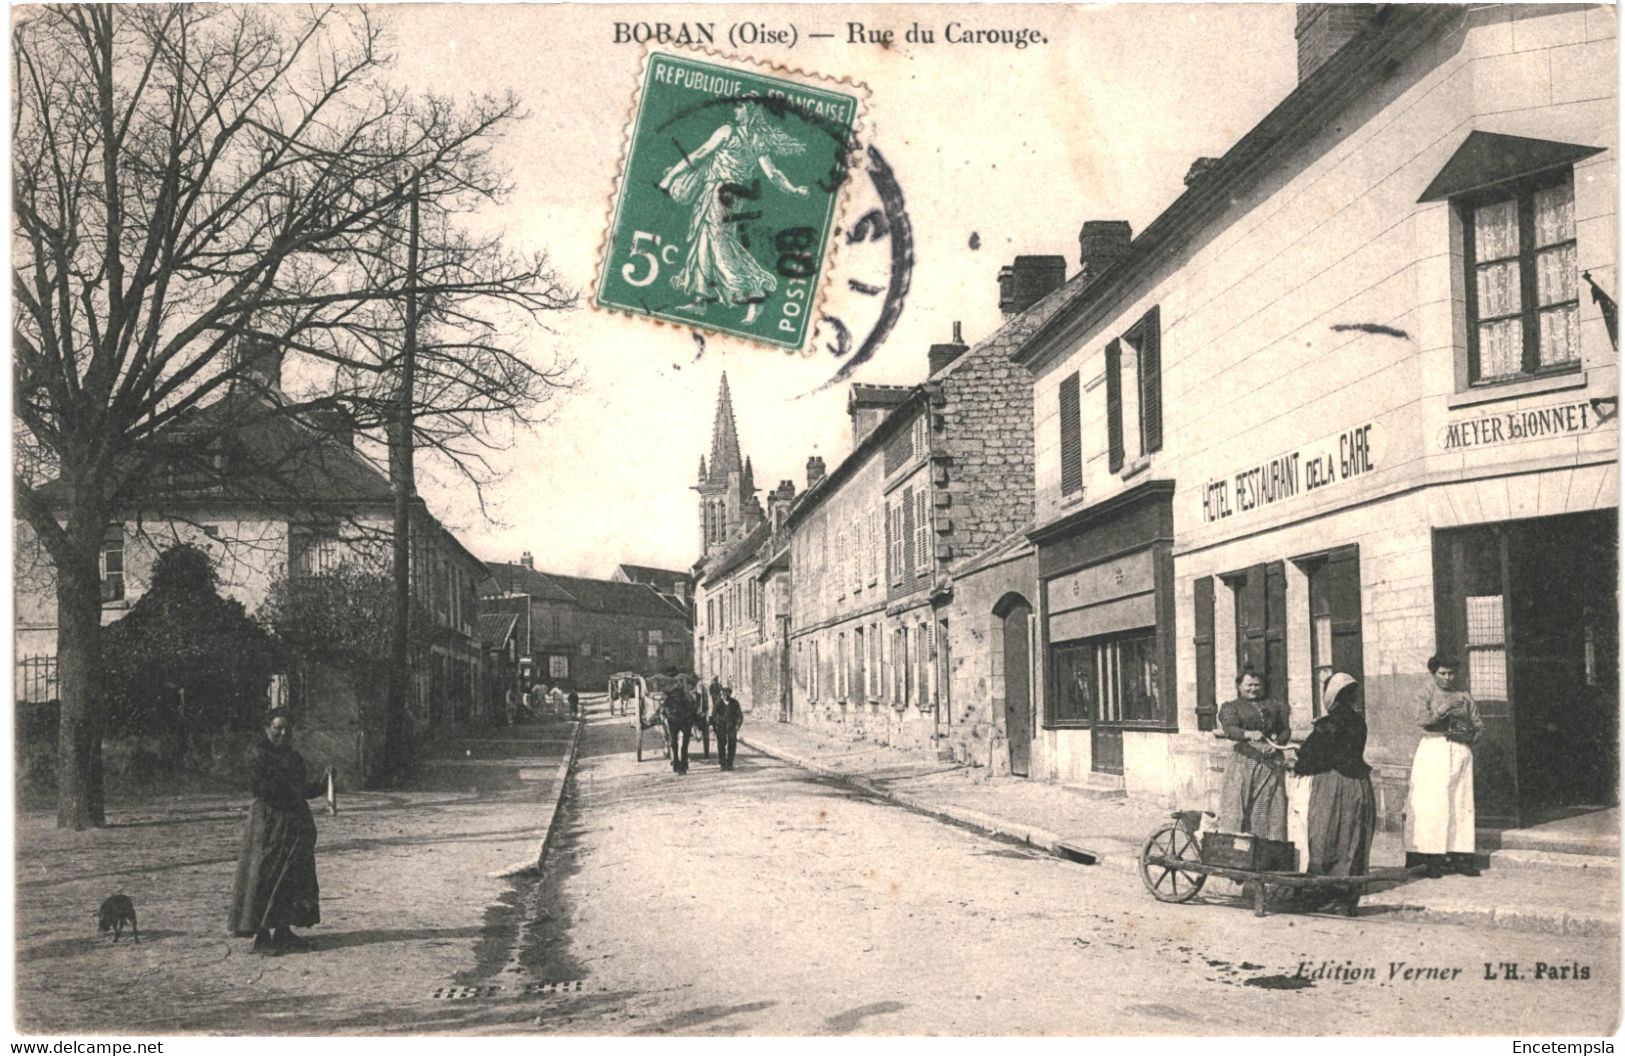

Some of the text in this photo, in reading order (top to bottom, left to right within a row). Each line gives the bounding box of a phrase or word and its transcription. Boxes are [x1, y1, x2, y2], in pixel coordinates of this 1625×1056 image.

[1445, 402, 1593, 449] MEYER LIONNET
[1235, 451, 1300, 513] RESTAURANT
[1340, 423, 1374, 480] GARE
